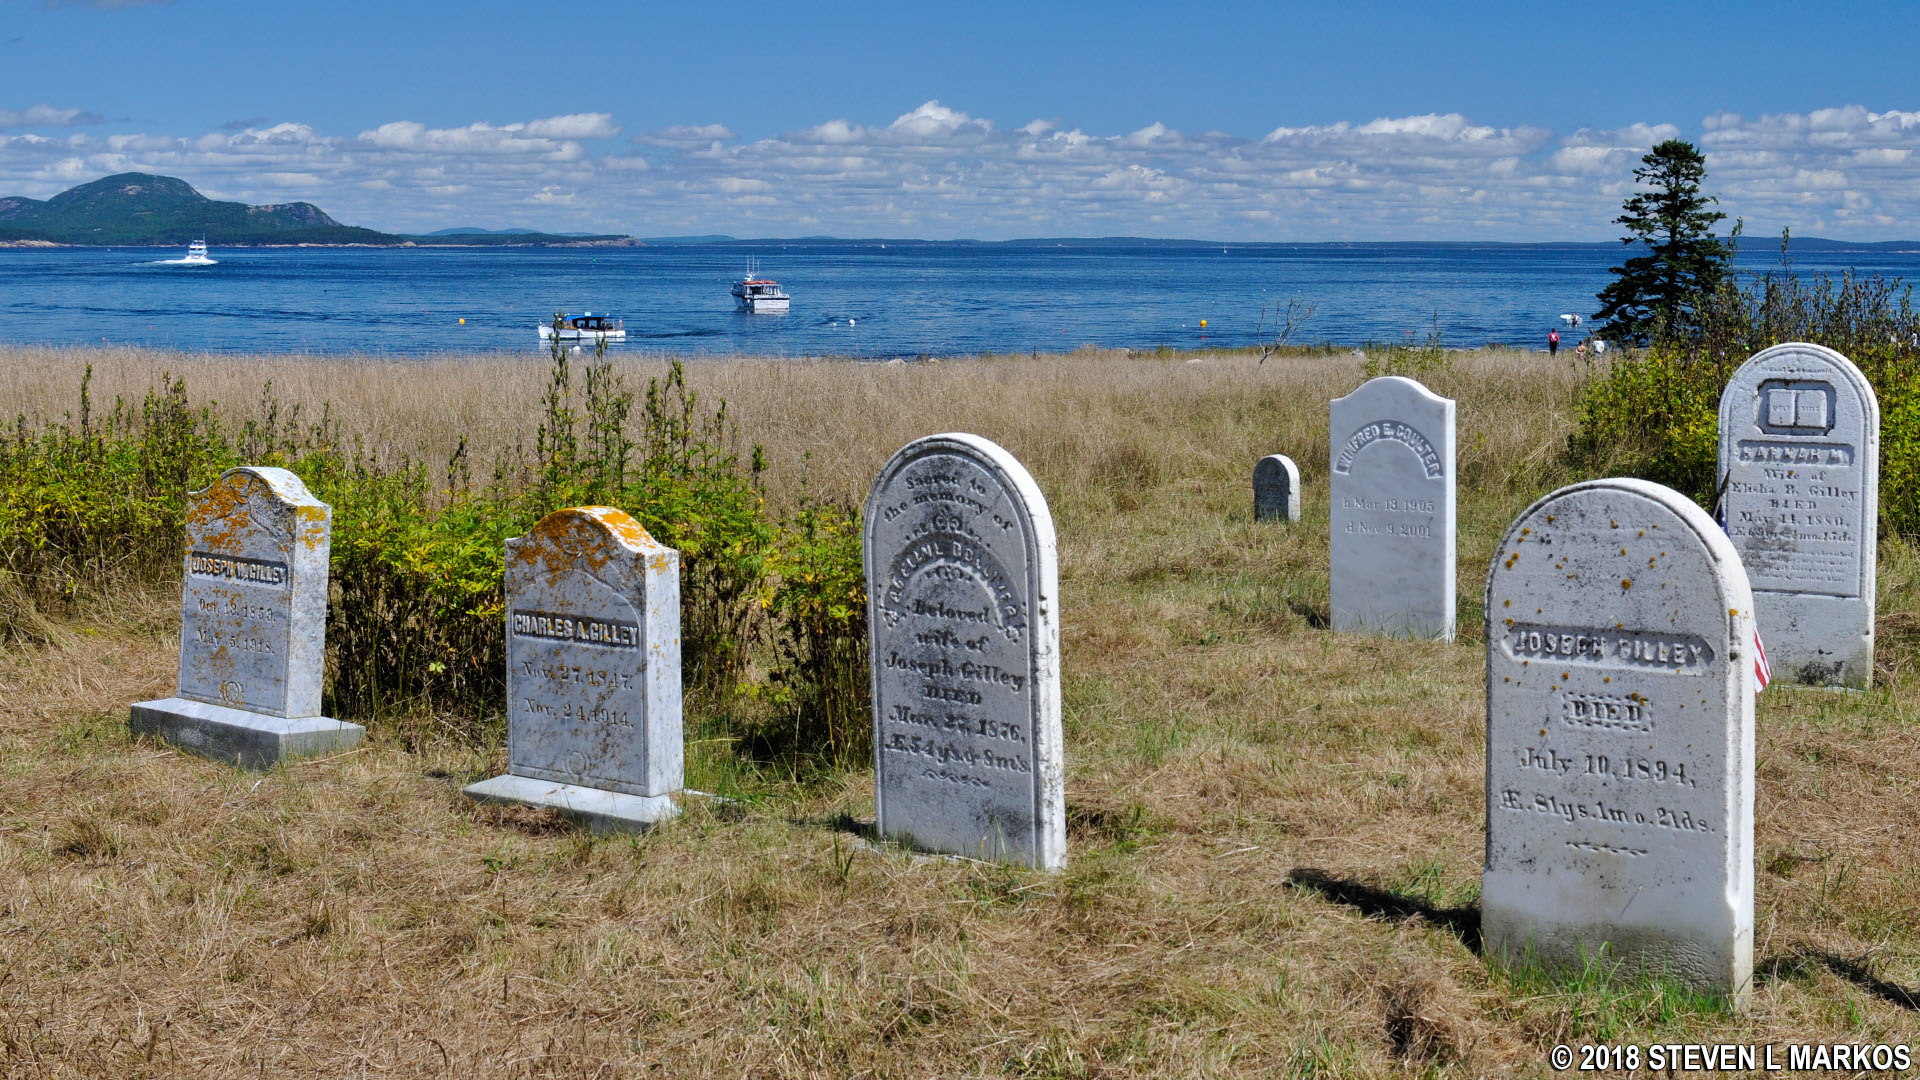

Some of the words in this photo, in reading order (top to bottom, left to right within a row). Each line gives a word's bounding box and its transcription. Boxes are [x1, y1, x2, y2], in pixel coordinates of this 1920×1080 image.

[1338, 425, 1380, 468] WINFRED
[1396, 425, 1441, 476] COULTER
[967, 477, 986, 496] to
[1731, 482, 1776, 494] Elisha
[1808, 485, 1858, 501] Gilley
[884, 502, 908, 522] the
[913, 492, 988, 516] memory
[992, 514, 1014, 532] of
[1404, 500, 1434, 513] 1905
[1770, 500, 1817, 509] DIED
[1400, 524, 1432, 537] 2001
[1740, 511, 1773, 527] May
[193, 557, 234, 577] JOSEPH
[249, 563, 286, 584] GILLEY
[913, 599, 990, 623] Beloved
[514, 614, 573, 638] CHARLES
[576, 621, 589, 640] A.
[590, 622, 638, 645] GILLEY
[916, 628, 959, 648] wife
[965, 635, 991, 652] of
[1514, 630, 1608, 658] JOSEPH
[1618, 638, 1703, 665] GILLEY
[885, 651, 955, 679] Joseph
[960, 660, 1026, 693] Gilley
[923, 685, 982, 705] DIED
[1570, 700, 1643, 724] DIED
[1520, 747, 1573, 777] July
